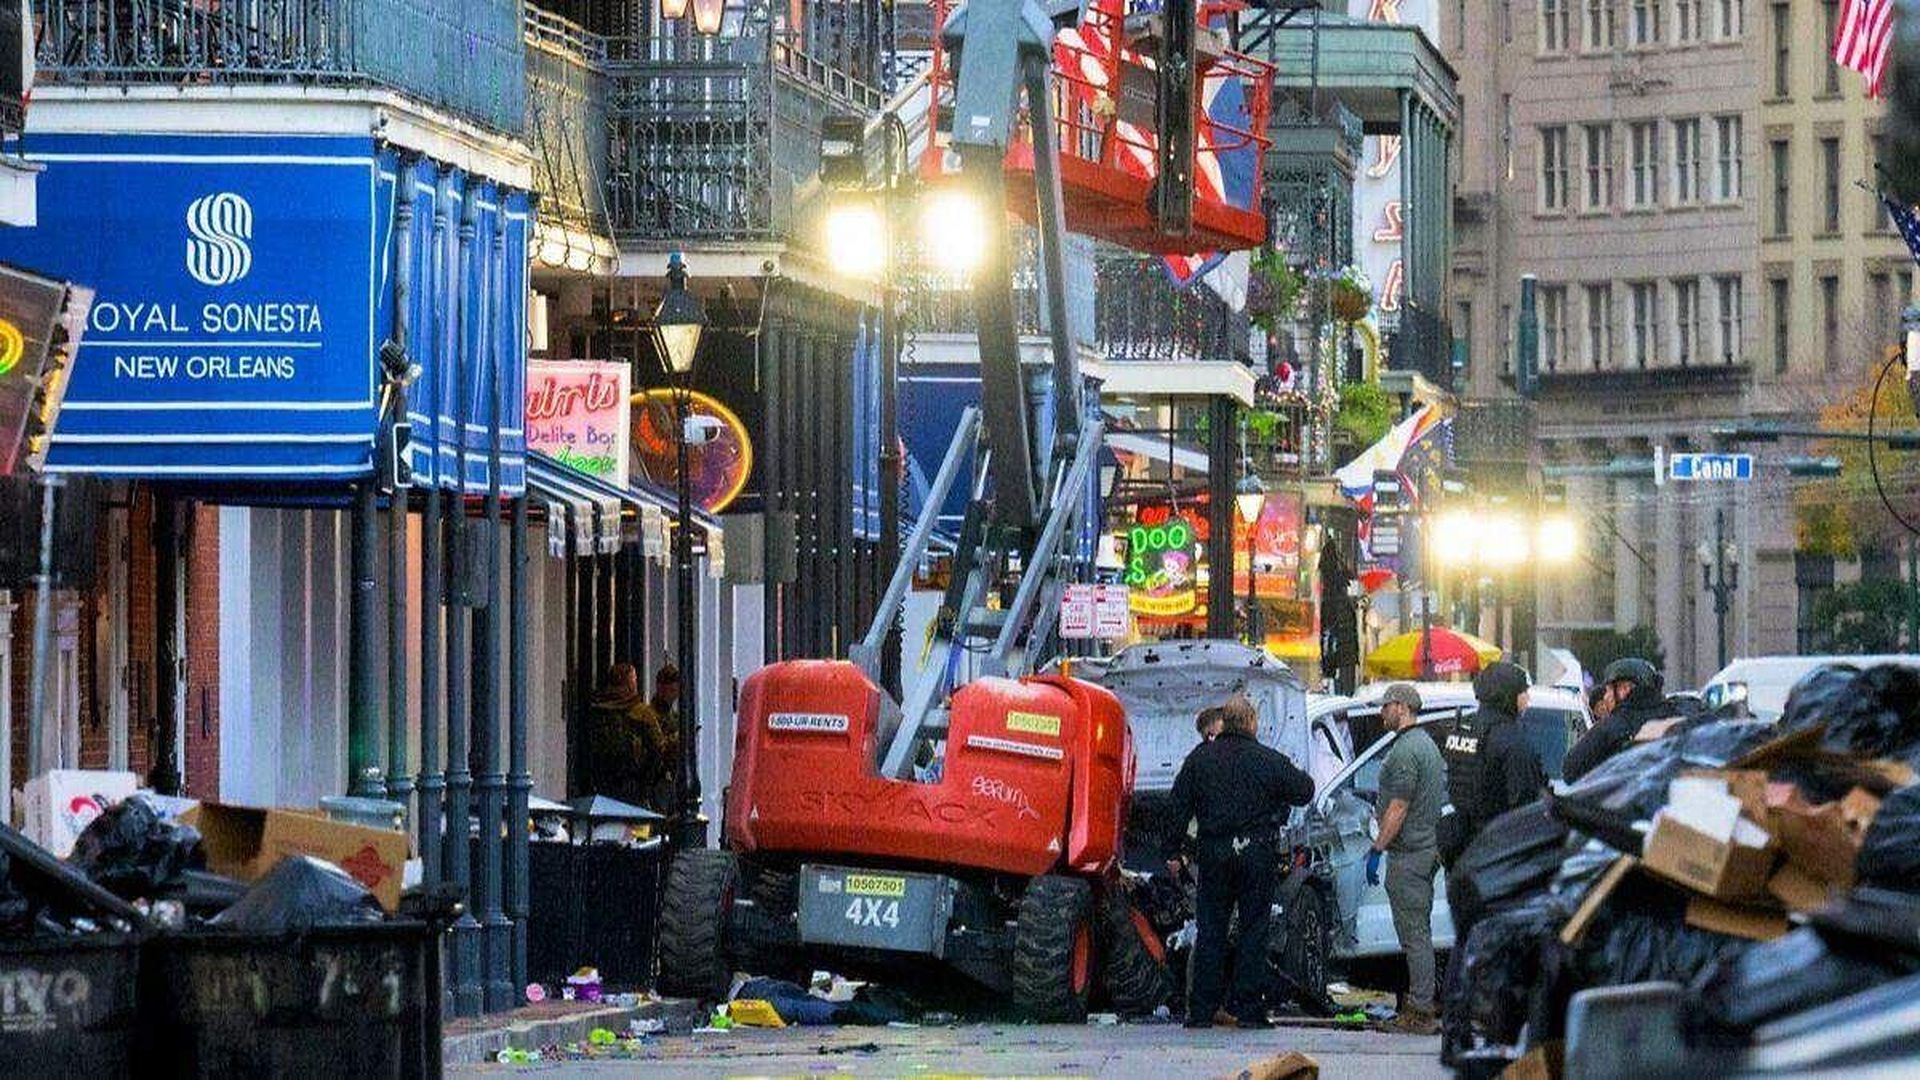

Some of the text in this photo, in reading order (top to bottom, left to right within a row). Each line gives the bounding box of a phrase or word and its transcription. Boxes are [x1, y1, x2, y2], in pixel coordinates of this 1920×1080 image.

[84, 303, 322, 333] OYAL SONESTA
[114, 356, 295, 379] NEW ORLEANS
[1690, 455, 1738, 480] Canal
[848, 877, 904, 892] 10507501
[845, 897, 900, 928] 4X4
